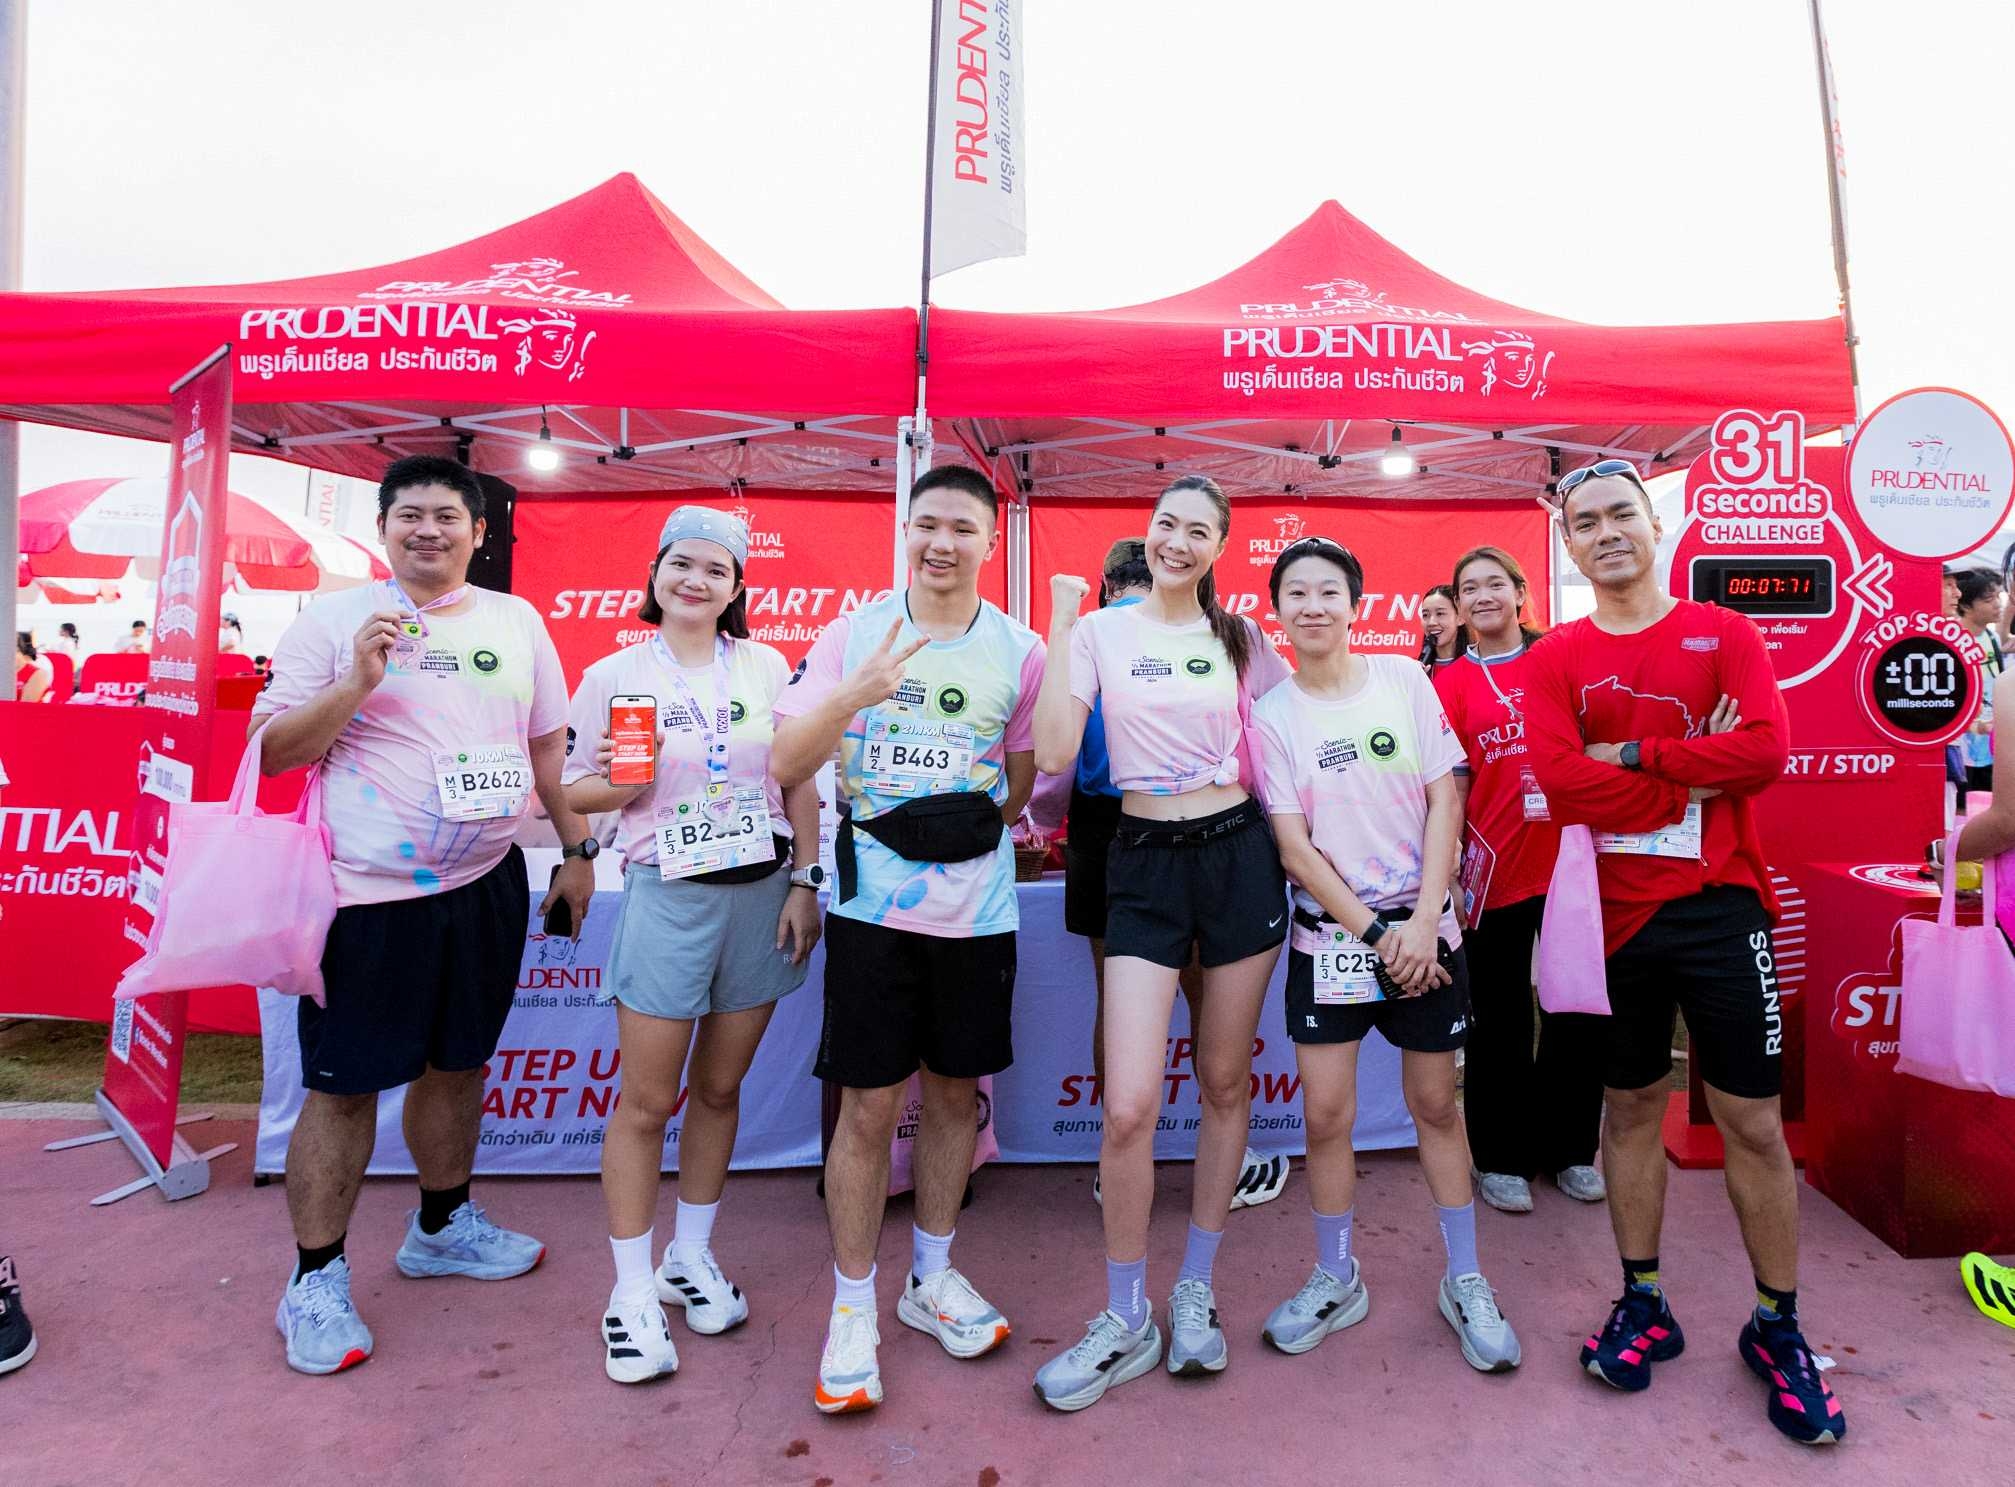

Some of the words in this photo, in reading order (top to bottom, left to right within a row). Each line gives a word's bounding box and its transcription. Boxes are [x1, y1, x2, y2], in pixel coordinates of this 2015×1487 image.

[376, 278, 634, 303] PRUDENTIAL
[1240, 298, 1480, 322] PRUDENTIAL
[239, 302, 498, 340] PRUDENTIAL
[1223, 325, 1463, 361] PRUDENTIAL
[240, 346, 369, 379] พรูเด็นเชียล
[380, 346, 497, 373] ประกันชีวิต
[1223, 364, 1343, 395] พรูเด็นเชียล
[1355, 366, 1464, 393] ประกันชีวิต
[1720, 419, 1795, 481] 31
[1871, 470, 1992, 492] PRUDENTIAL
[1702, 489, 1822, 514] seconds
[1704, 524, 1822, 541] CHALLENGE
[1728, 578, 1810, 594] 00:07:71
[550, 589, 645, 618] STEP
[744, 587, 836, 616] TART
[1864, 616, 1908, 649] TOP
[1915, 613, 1984, 665] SCORE
[1886, 697, 1955, 708] milliseconds
[618, 744, 637, 752] STEP
[637, 744, 649, 752] UP
[870, 744, 880, 756] M
[1320, 738, 1347, 750] Scenic
[1324, 742, 1356, 757] MARATHON
[871, 758, 877, 770] 2
[892, 745, 949, 769] B463
[1321, 752, 1355, 768] PRANBURI
[1782, 755, 1815, 775] RT
[1833, 755, 1896, 775] STOP
[445, 775, 456, 786] M
[461, 770, 522, 791] B2622
[449, 789, 457, 799] 3
[664, 829, 673, 841] F
[681, 815, 754, 845] B23
[667, 844, 675, 855] 3
[1321, 954, 1329, 965] F
[1321, 968, 1329, 979] 3
[1749, 930, 1782, 1056] RUNTOS
[1306, 1015, 1319, 1028] TS.
